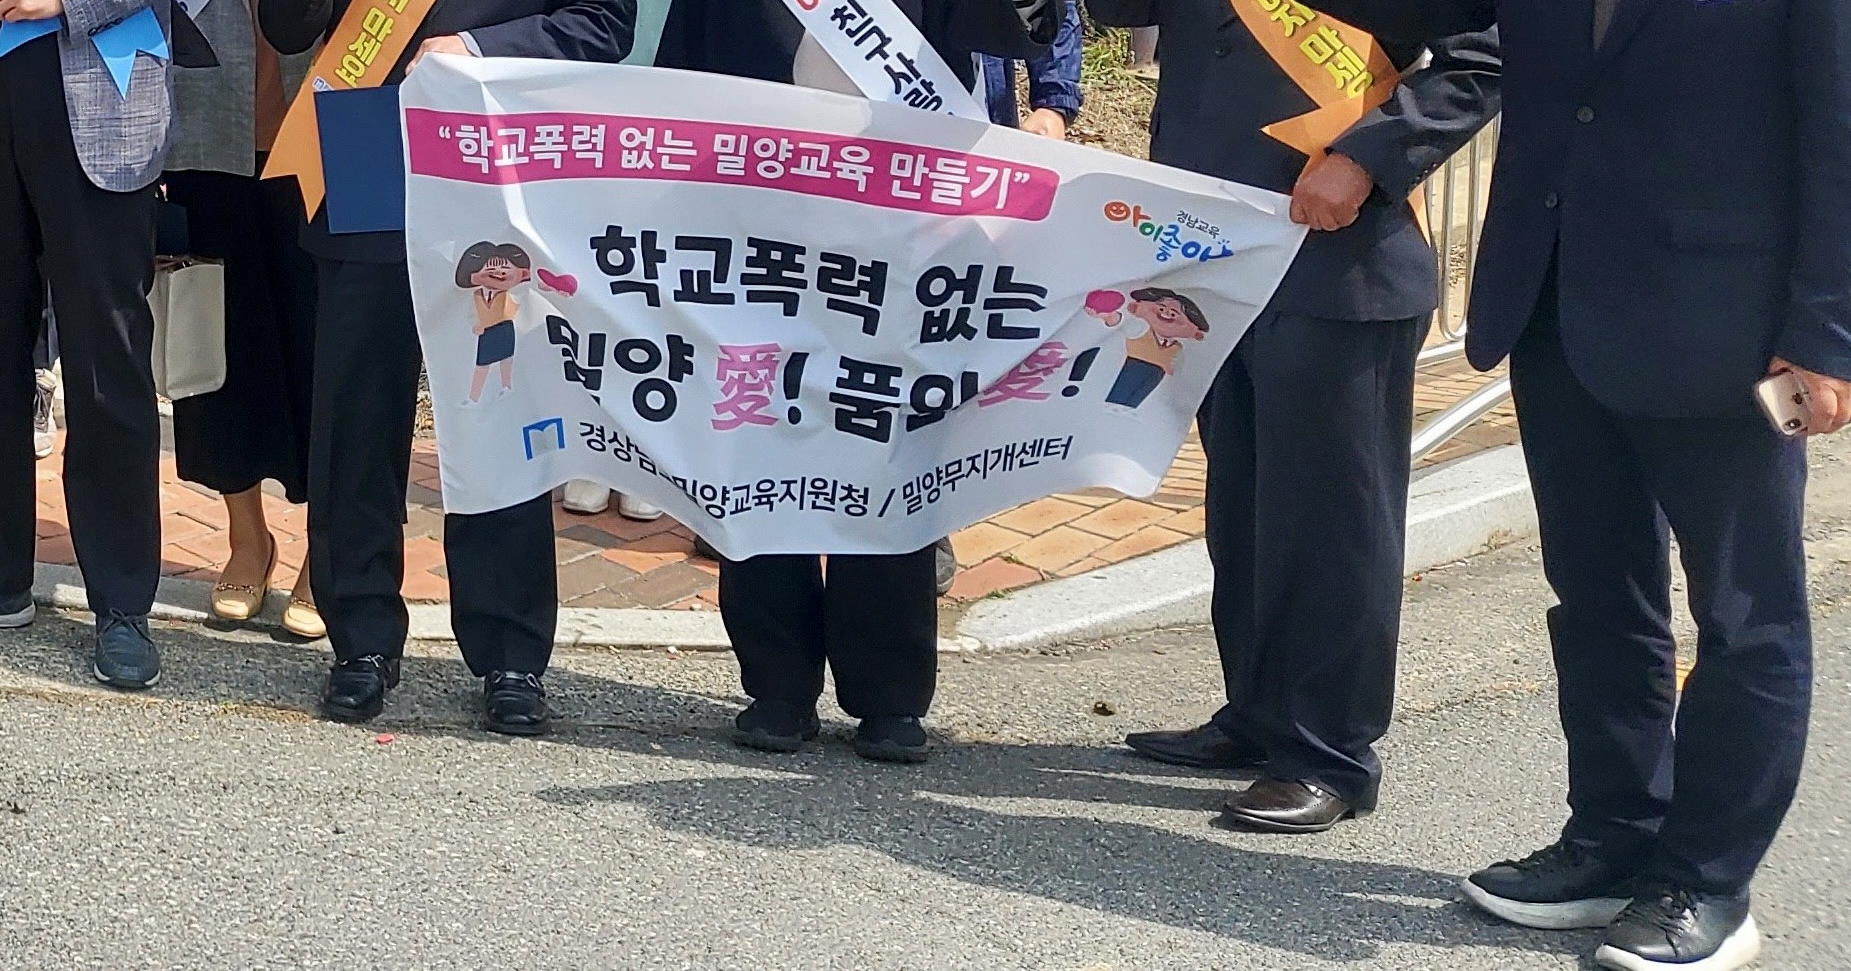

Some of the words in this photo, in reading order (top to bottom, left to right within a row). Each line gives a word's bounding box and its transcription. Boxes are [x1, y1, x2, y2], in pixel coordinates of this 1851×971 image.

[334, 6, 395, 89] 마세요
[619, 126, 697, 172] 없는
[712, 133, 873, 193] 밀양교육
[1177, 210, 1220, 239] 경남교육
[590, 224, 889, 336] 학교폭력
[916, 264, 1048, 343] 없는
[545, 315, 694, 423] 밀양
[578, 421, 870, 520] 경상남밀양교육지원청
[901, 434, 1073, 516] 밀양무지개센터
